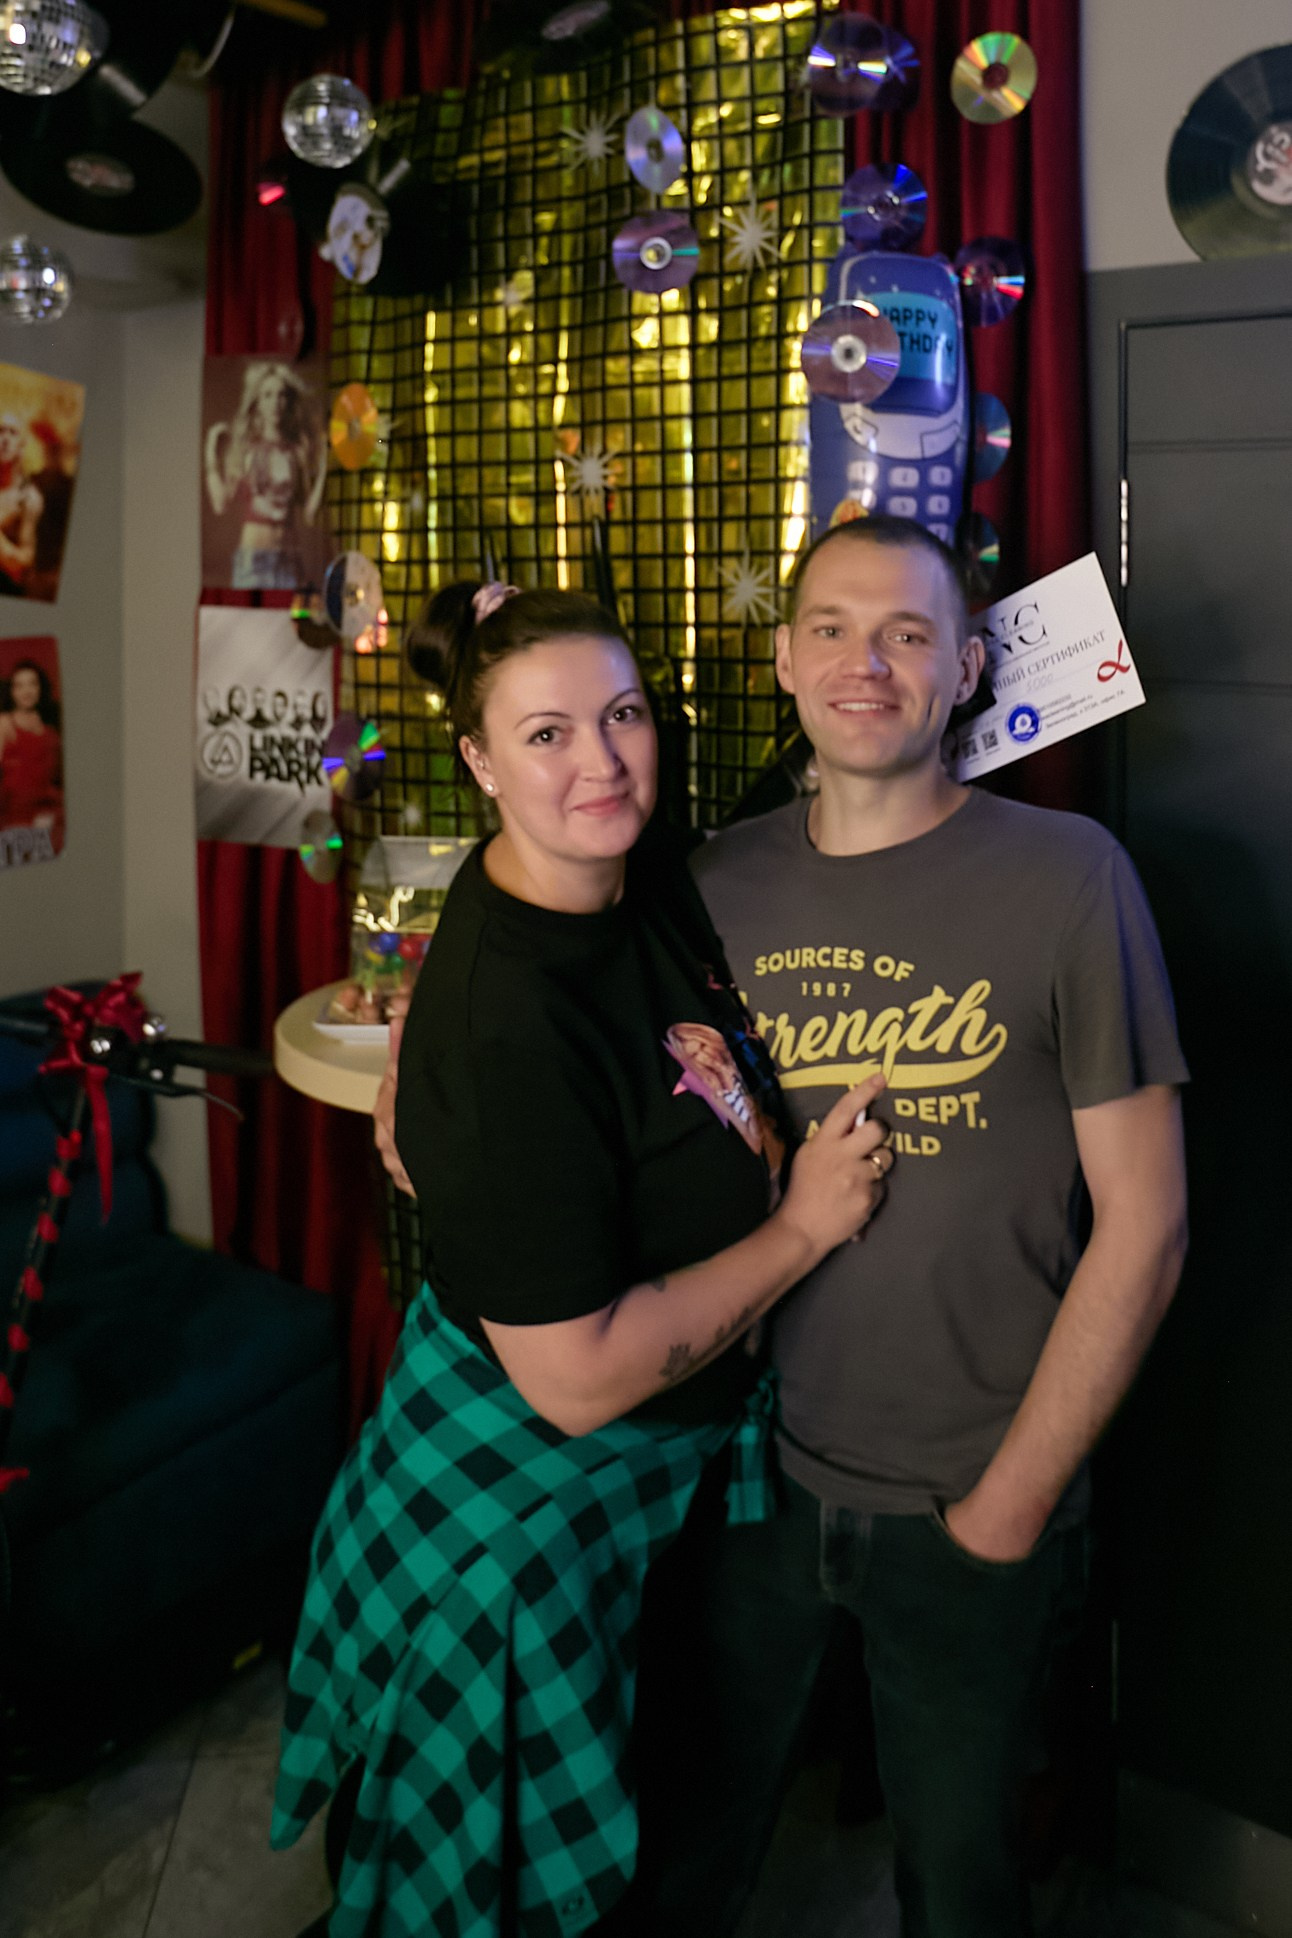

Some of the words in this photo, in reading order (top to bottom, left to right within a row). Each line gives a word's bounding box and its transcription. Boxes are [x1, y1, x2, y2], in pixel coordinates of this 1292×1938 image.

[882, 306, 938, 329] APPY
[897, 331, 954, 355] THDY
[1027, 629, 1106, 677] СЕРТИФИКАТ
[249, 756, 323, 793] PARK
[754, 947, 866, 976] SOURCES
[873, 956, 915, 981] OF
[801, 981, 852, 997] 1987
[755, 979, 1008, 1088] trength
[894, 1091, 988, 1129] DEPT.
[884, 1130, 942, 1156] ILD
